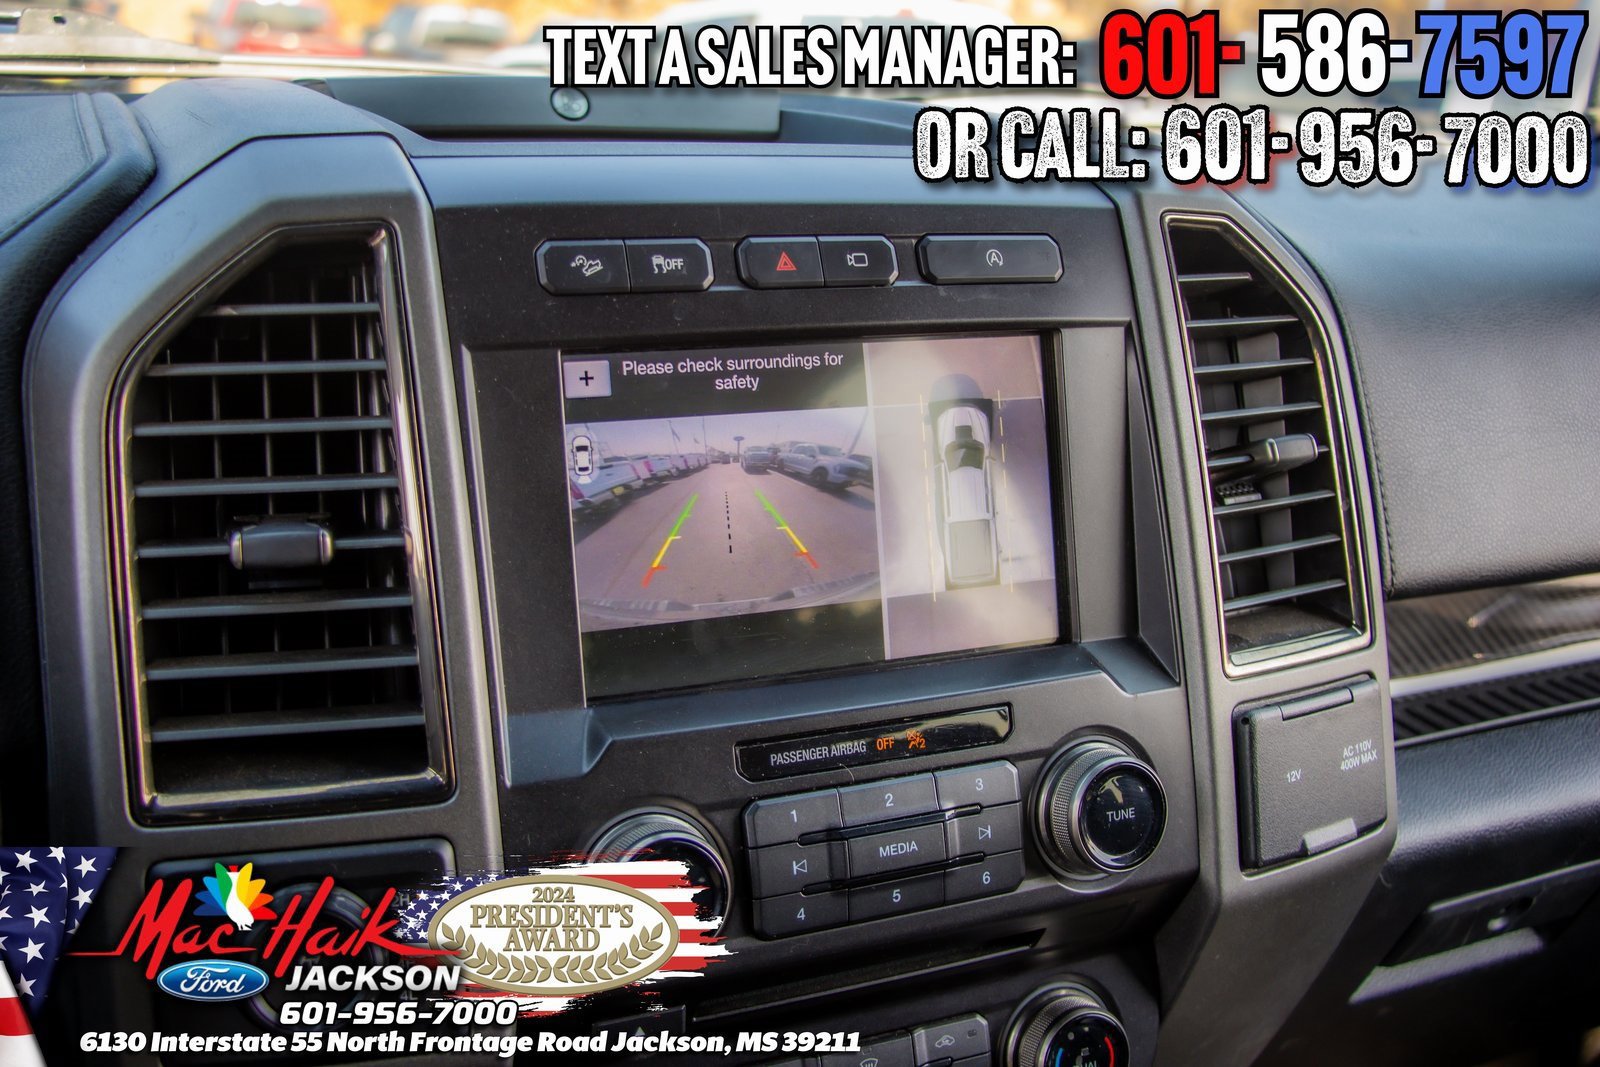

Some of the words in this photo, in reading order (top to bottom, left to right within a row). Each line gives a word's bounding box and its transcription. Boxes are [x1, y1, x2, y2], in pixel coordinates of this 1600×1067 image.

[664, 258, 684, 270] OFF
[622, 360, 673, 376] Please
[677, 356, 723, 373] check
[727, 353, 820, 371] surroundings
[824, 352, 844, 365] for
[715, 374, 759, 391] safety
[770, 746, 829, 766] PASSENGER
[830, 741, 867, 757] AIRBAG
[876, 737, 895, 751] OFF
[1343, 746, 1354, 758] AC
[1355, 739, 1372, 754] 110V
[1340, 757, 1360, 770] 400W
[1361, 750, 1377, 763] MAX
[1286, 768, 1302, 783] 12V
[975, 778, 984, 791] 3
[884, 793, 894, 807] 2
[790, 809, 799, 823] 1
[1106, 807, 1136, 823] TUNE
[878, 841, 918, 858] MEDIA
[982, 870, 991, 885] 6
[892, 889, 902, 903] 5
[796, 907, 806, 921] 4
